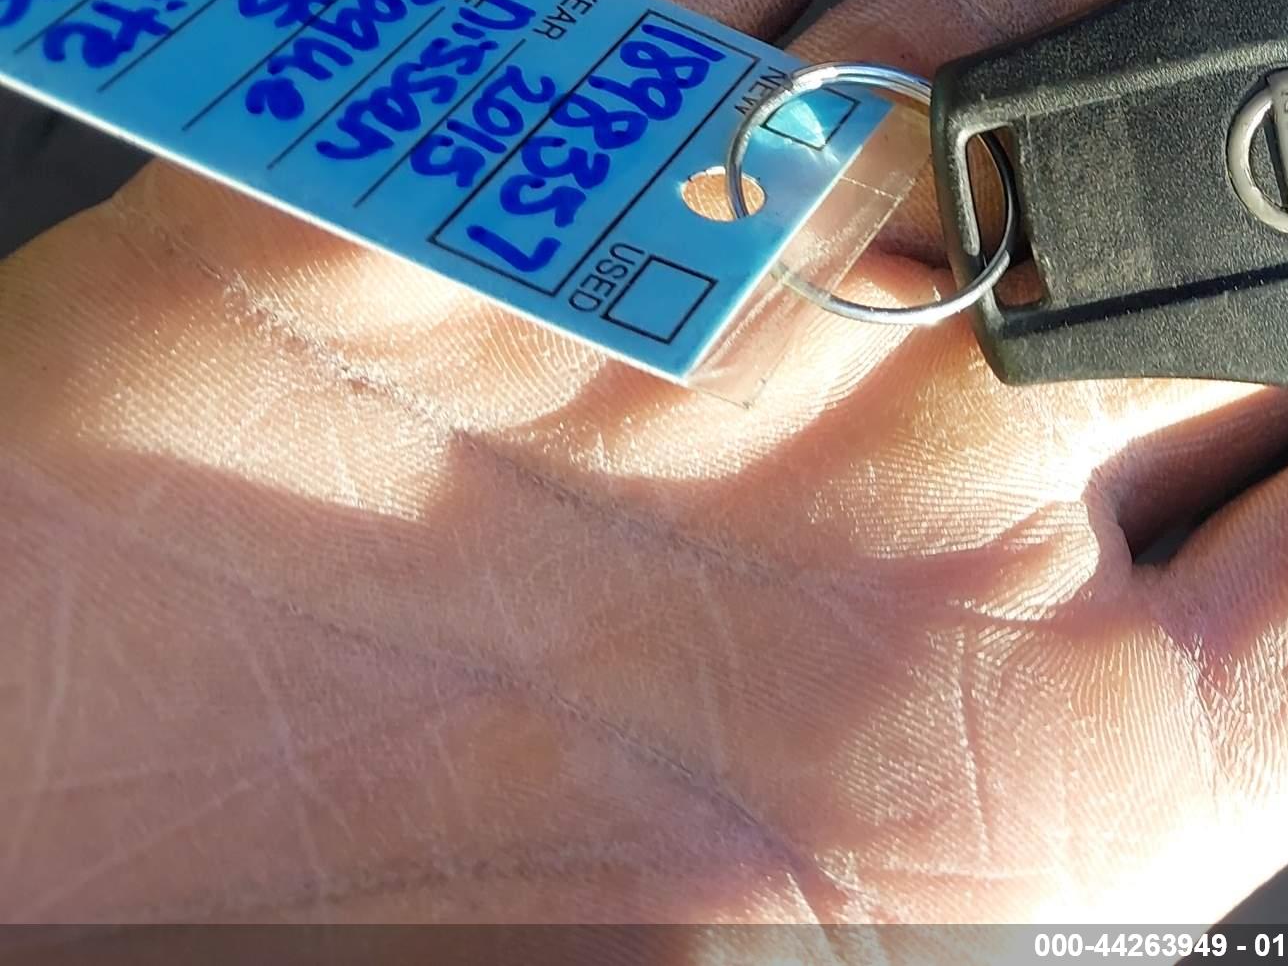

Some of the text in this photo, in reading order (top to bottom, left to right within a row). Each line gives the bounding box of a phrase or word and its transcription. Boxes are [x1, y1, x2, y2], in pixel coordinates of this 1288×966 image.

[410, 64, 555, 187] 2015
[734, 65, 786, 115] NEW
[466, 24, 726, 273] 1898357
[568, 242, 645, 313] USED
